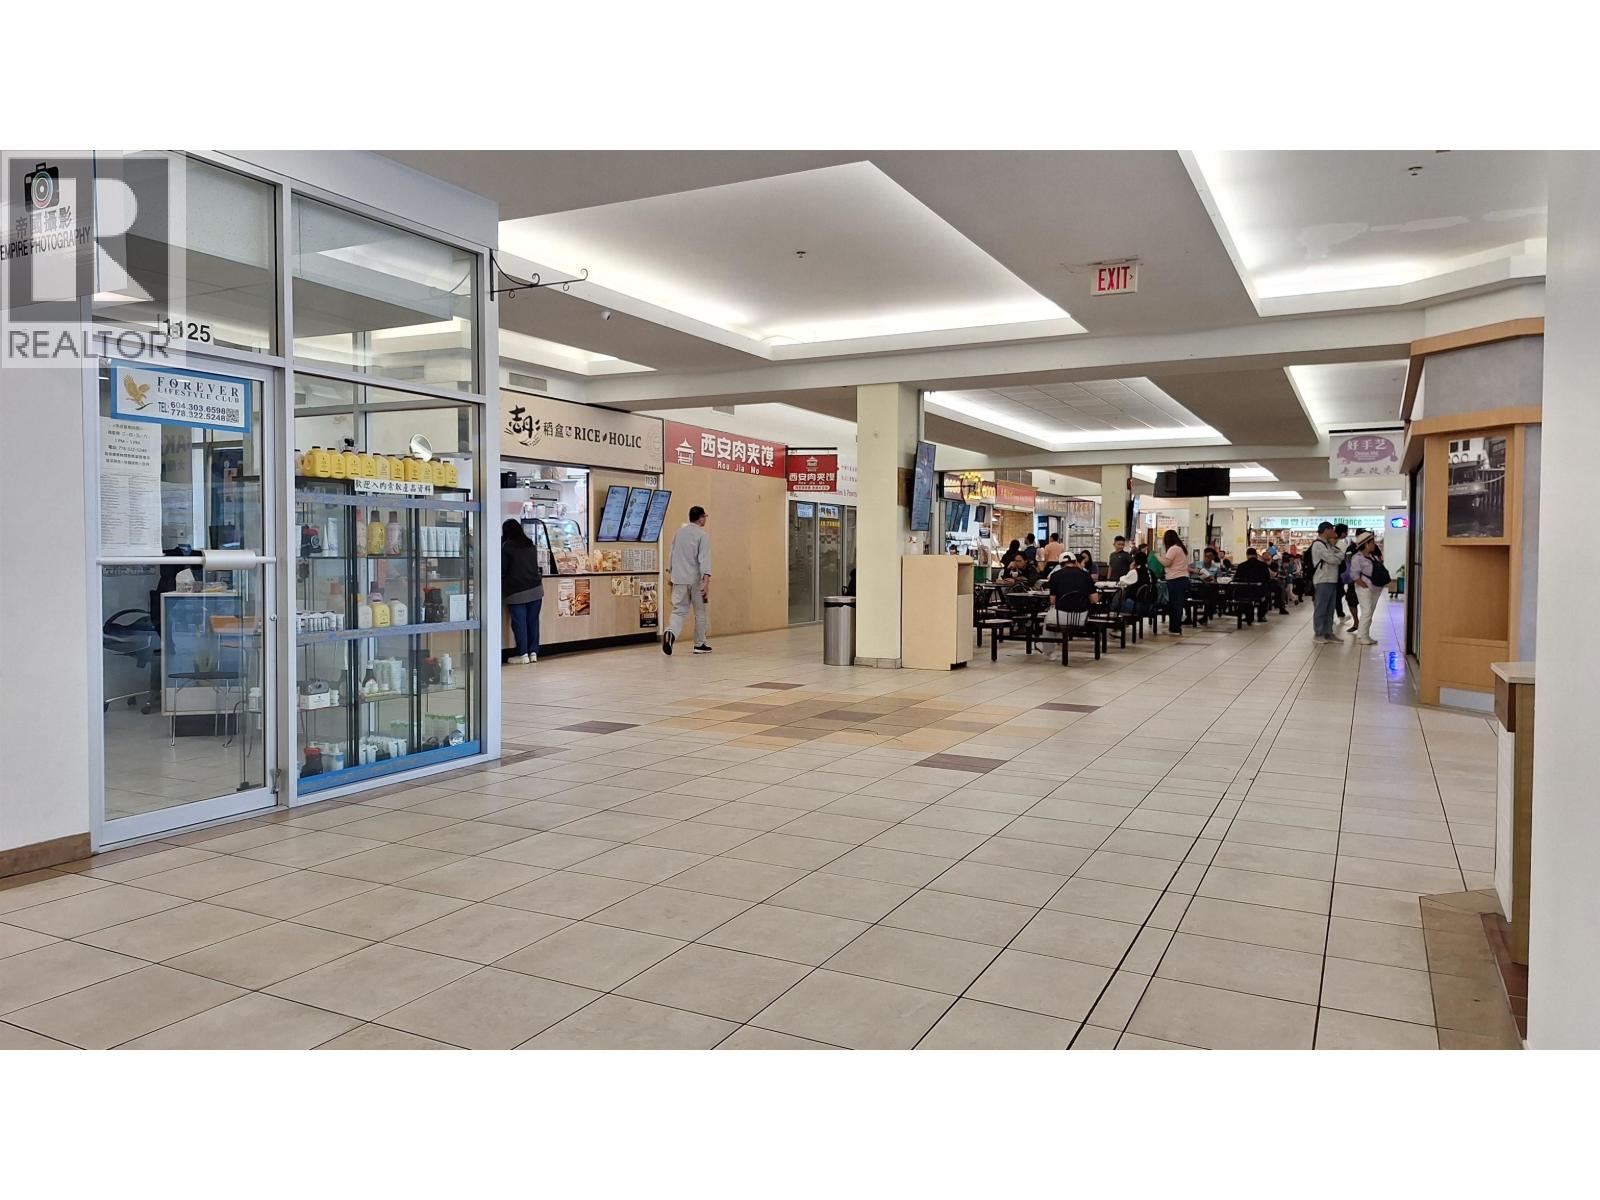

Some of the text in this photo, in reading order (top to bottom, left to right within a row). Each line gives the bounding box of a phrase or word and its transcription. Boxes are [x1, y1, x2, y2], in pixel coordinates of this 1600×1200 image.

[1098, 266, 1130, 292] EXIT
[163, 318, 211, 343] 1125
[157, 376, 240, 398] FOREVER
[157, 387, 240, 404] LIFESTYLE CLUB
[170, 401, 226, 415] 604.303.6598
[170, 408, 226, 422] 778.322.5248
[574, 426, 642, 449] RICE HOLIC
[1347, 439, 1387, 450] 好手艺
[701, 433, 774, 468] 西安肉夹馍
[717, 461, 730, 471] Rou
[750, 467, 760, 475] Mo
[789, 472, 835, 482] 西安肉夹馍
